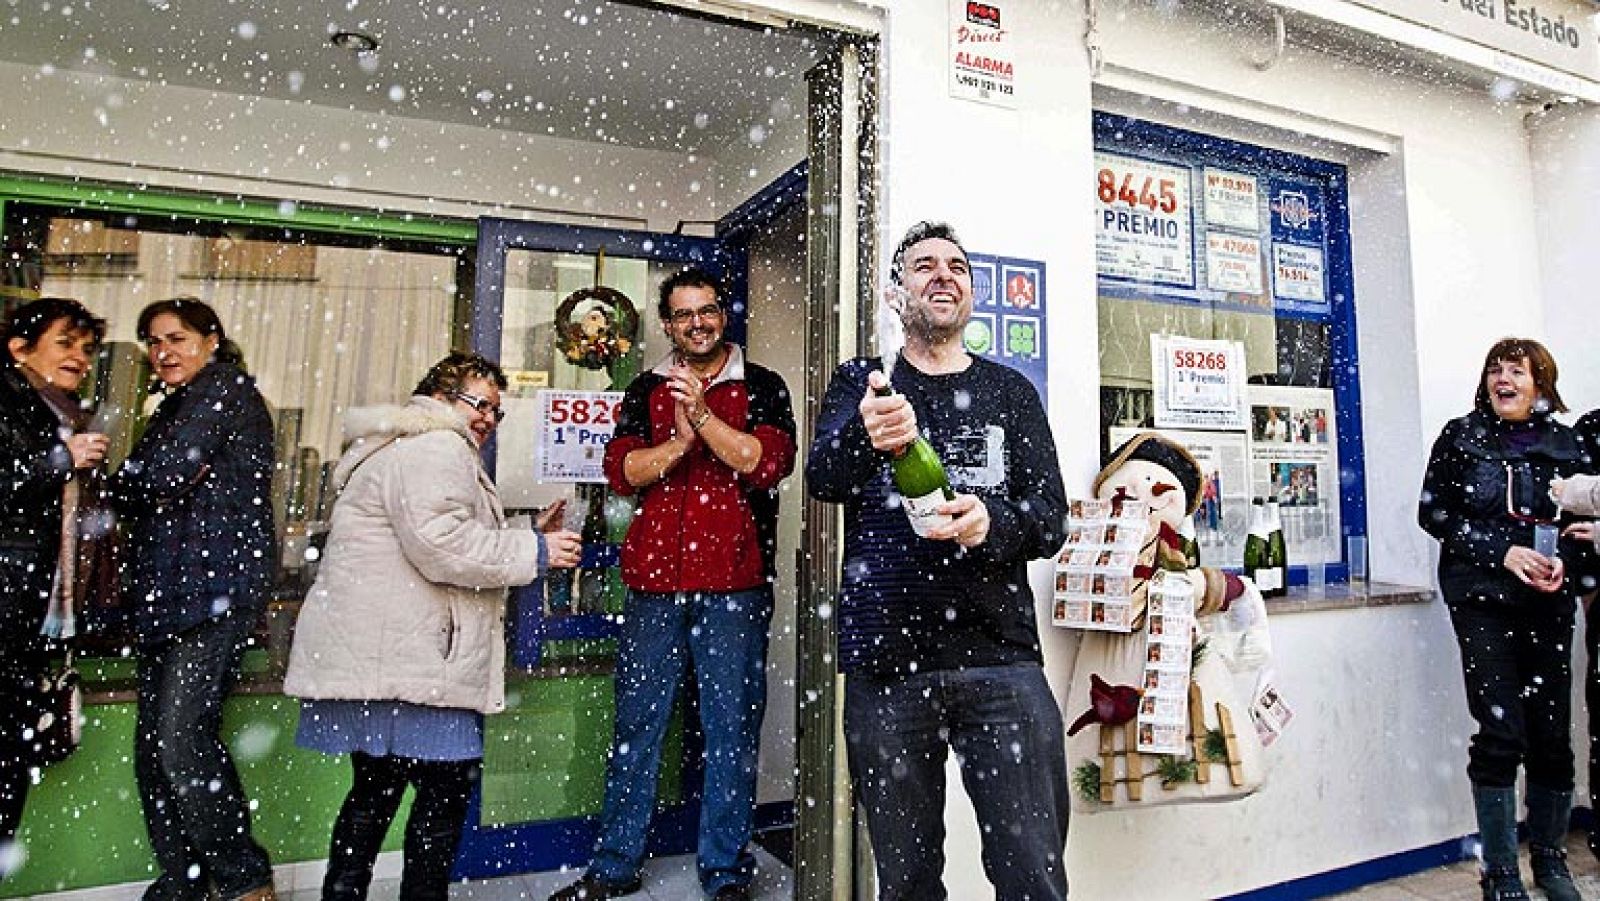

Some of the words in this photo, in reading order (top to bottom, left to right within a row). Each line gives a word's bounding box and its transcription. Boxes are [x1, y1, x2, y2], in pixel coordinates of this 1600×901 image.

[1504, 0, 1579, 48] Estado
[955, 52, 1014, 75] ALARMA
[1097, 168, 1178, 214] 8445
[1103, 209, 1178, 239] PREMIO
[1174, 350, 1226, 370] 58268
[1190, 370, 1226, 385] Premio
